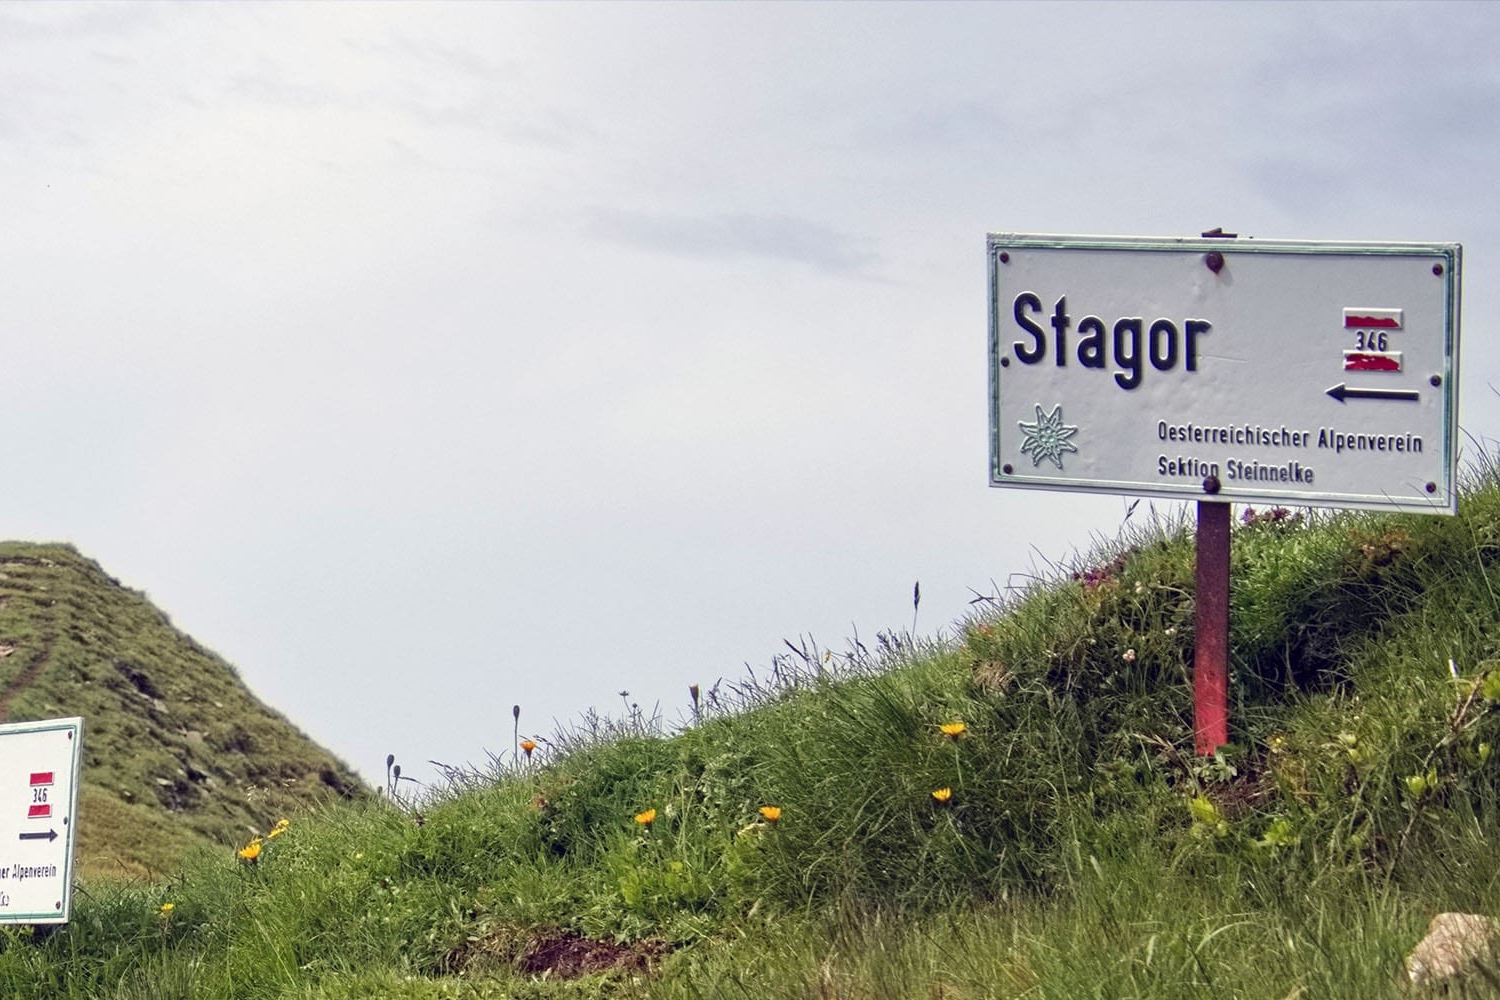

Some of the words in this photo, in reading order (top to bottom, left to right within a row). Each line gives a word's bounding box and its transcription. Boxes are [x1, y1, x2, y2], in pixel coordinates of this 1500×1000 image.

[1012, 291, 1213, 390] Stagor
[1355, 330, 1388, 352] 346
[1157, 420, 1310, 448] Oesterreichischer
[1317, 427, 1423, 453] Alpenverein
[1157, 455, 1219, 478] Sektion
[1227, 458, 1315, 484] Steinnelke
[32, 788, 48, 803] 346
[12, 863, 57, 882] Alpenverein
